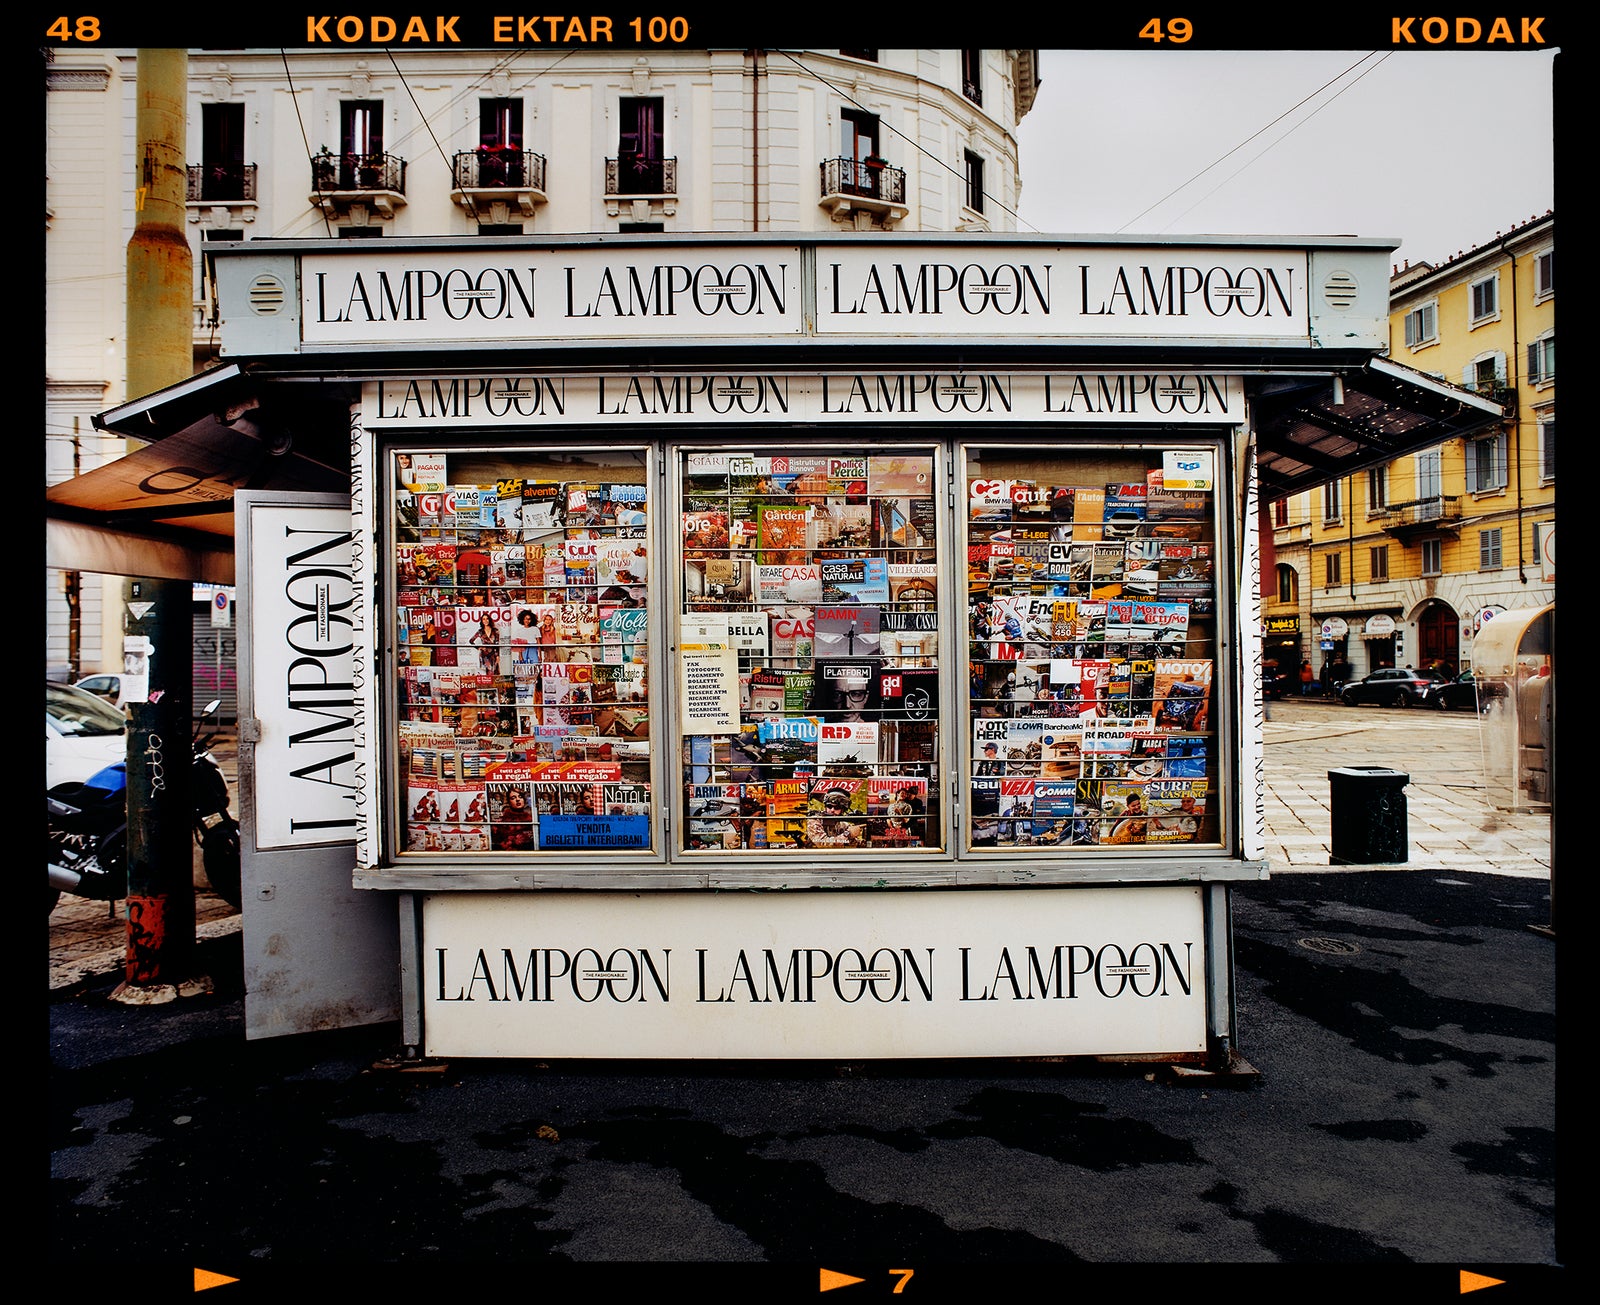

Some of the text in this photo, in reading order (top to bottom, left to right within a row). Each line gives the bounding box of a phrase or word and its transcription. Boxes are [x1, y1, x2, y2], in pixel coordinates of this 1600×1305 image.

[315, 263, 788, 323] LAMPOON LAMPOON
[829, 263, 1294, 318] LAMPOON LAMPOON
[376, 374, 1229, 419] LAMPOON LAMPOON LAMPOON LAMPOON
[523, 487, 558, 497] alvento
[970, 480, 1017, 498] car
[765, 511, 805, 521] Garden
[760, 567, 817, 581] RIFARE CASA
[822, 564, 848, 573] casa
[822, 572, 864, 580] NATURALE
[817, 609, 857, 620] DAMN
[1135, 605, 1166, 615] MOTO
[407, 608, 433, 628] Taglie
[1144, 614, 1187, 625] CICLISMO
[728, 626, 764, 636] BELLA
[285, 525, 357, 835] LAMPOON
[578, 773, 609, 781] regalo
[816, 781, 854, 793] RAIDS
[1151, 781, 1192, 791] SURF
[695, 786, 721, 798] ARMI
[1160, 790, 1205, 798] CASTING
[576, 823, 611, 833] VENDITA
[545, 834, 643, 845] BIGLIETTI INTERURBANI
[435, 942, 1194, 1003] LAMPOON LAMPOON LAMPOON
